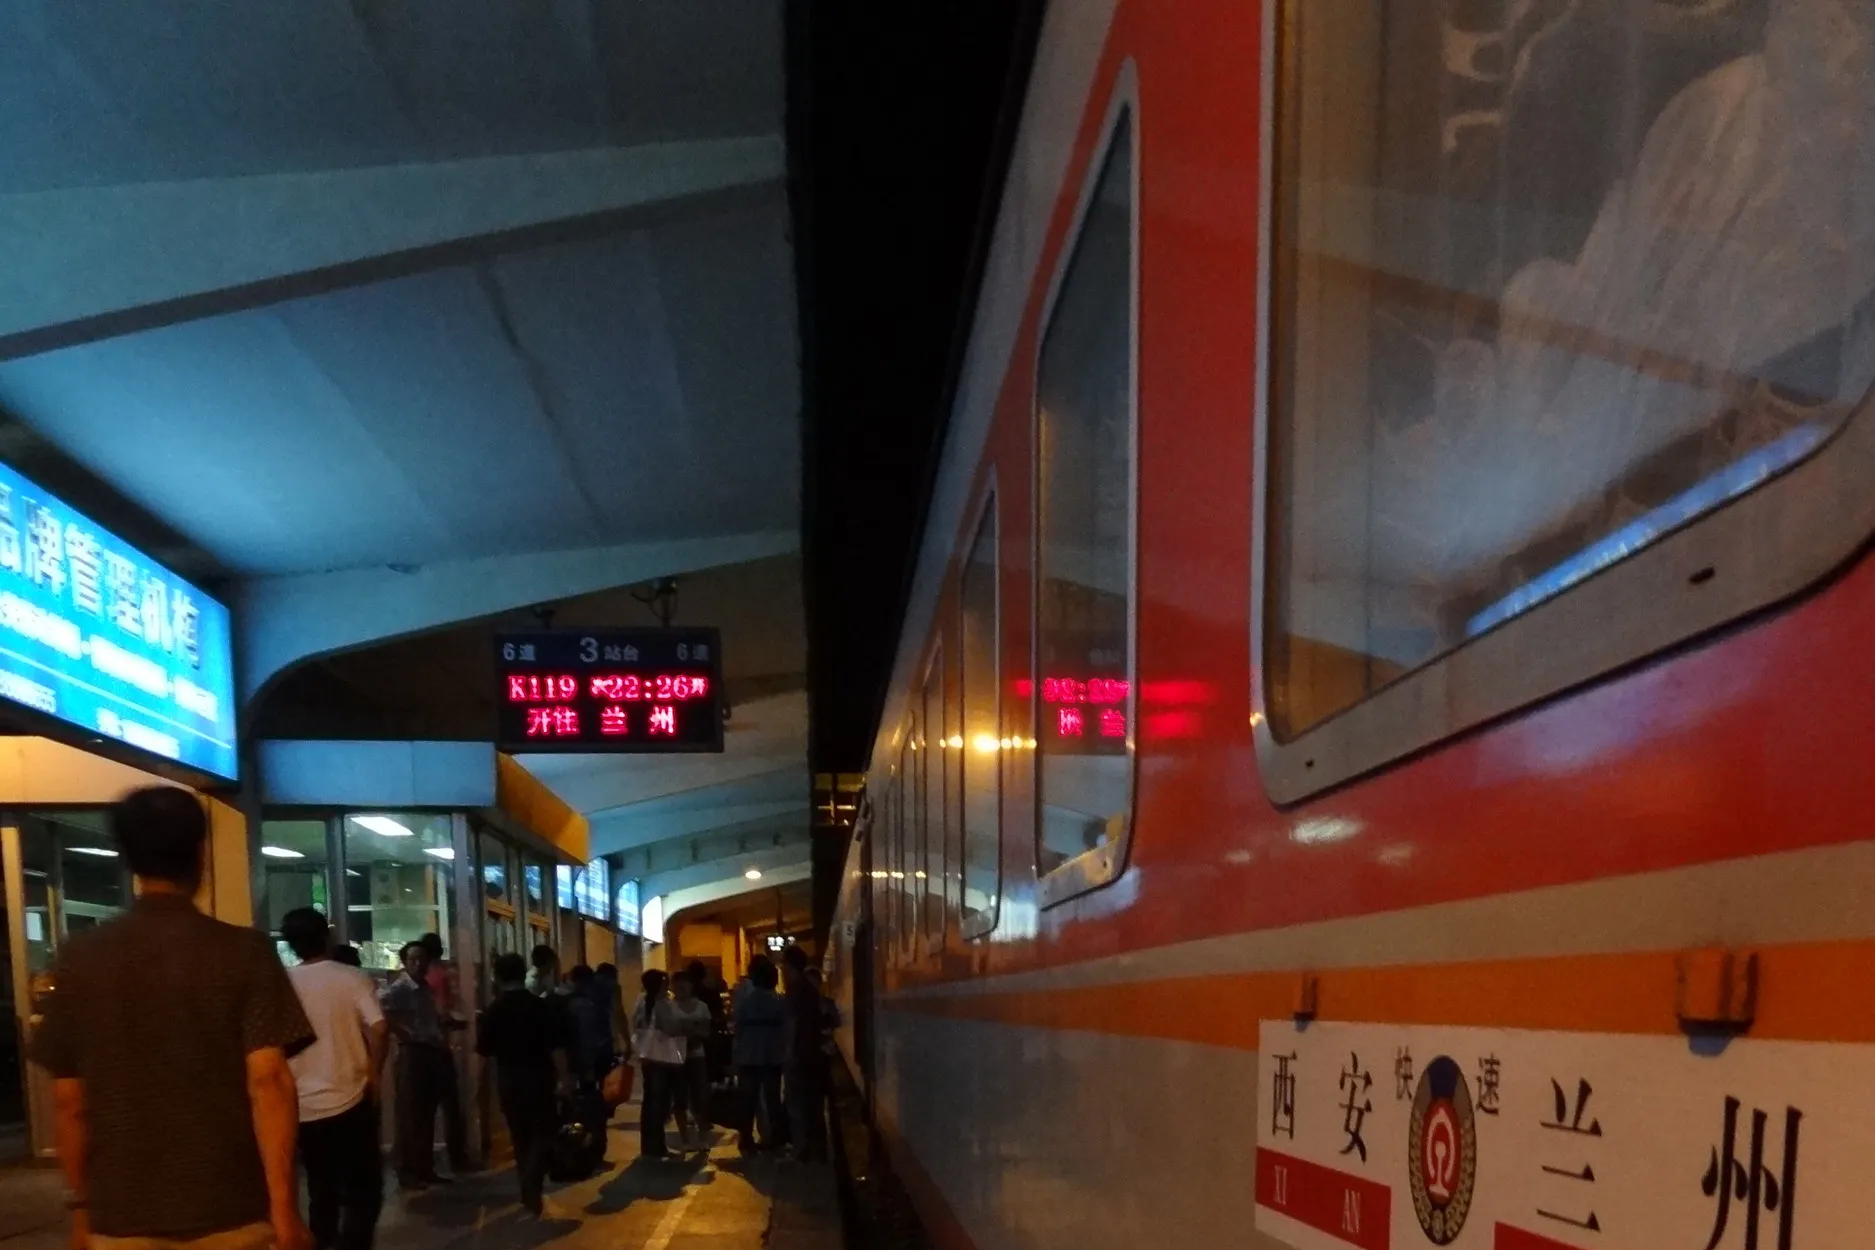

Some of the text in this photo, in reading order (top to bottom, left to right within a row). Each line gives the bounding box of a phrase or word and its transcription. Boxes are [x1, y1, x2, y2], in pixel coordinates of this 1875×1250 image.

[508, 675, 577, 700] K119
[1272, 1050, 1373, 1163] 西安
[1342, 1188, 1361, 1234] AN
